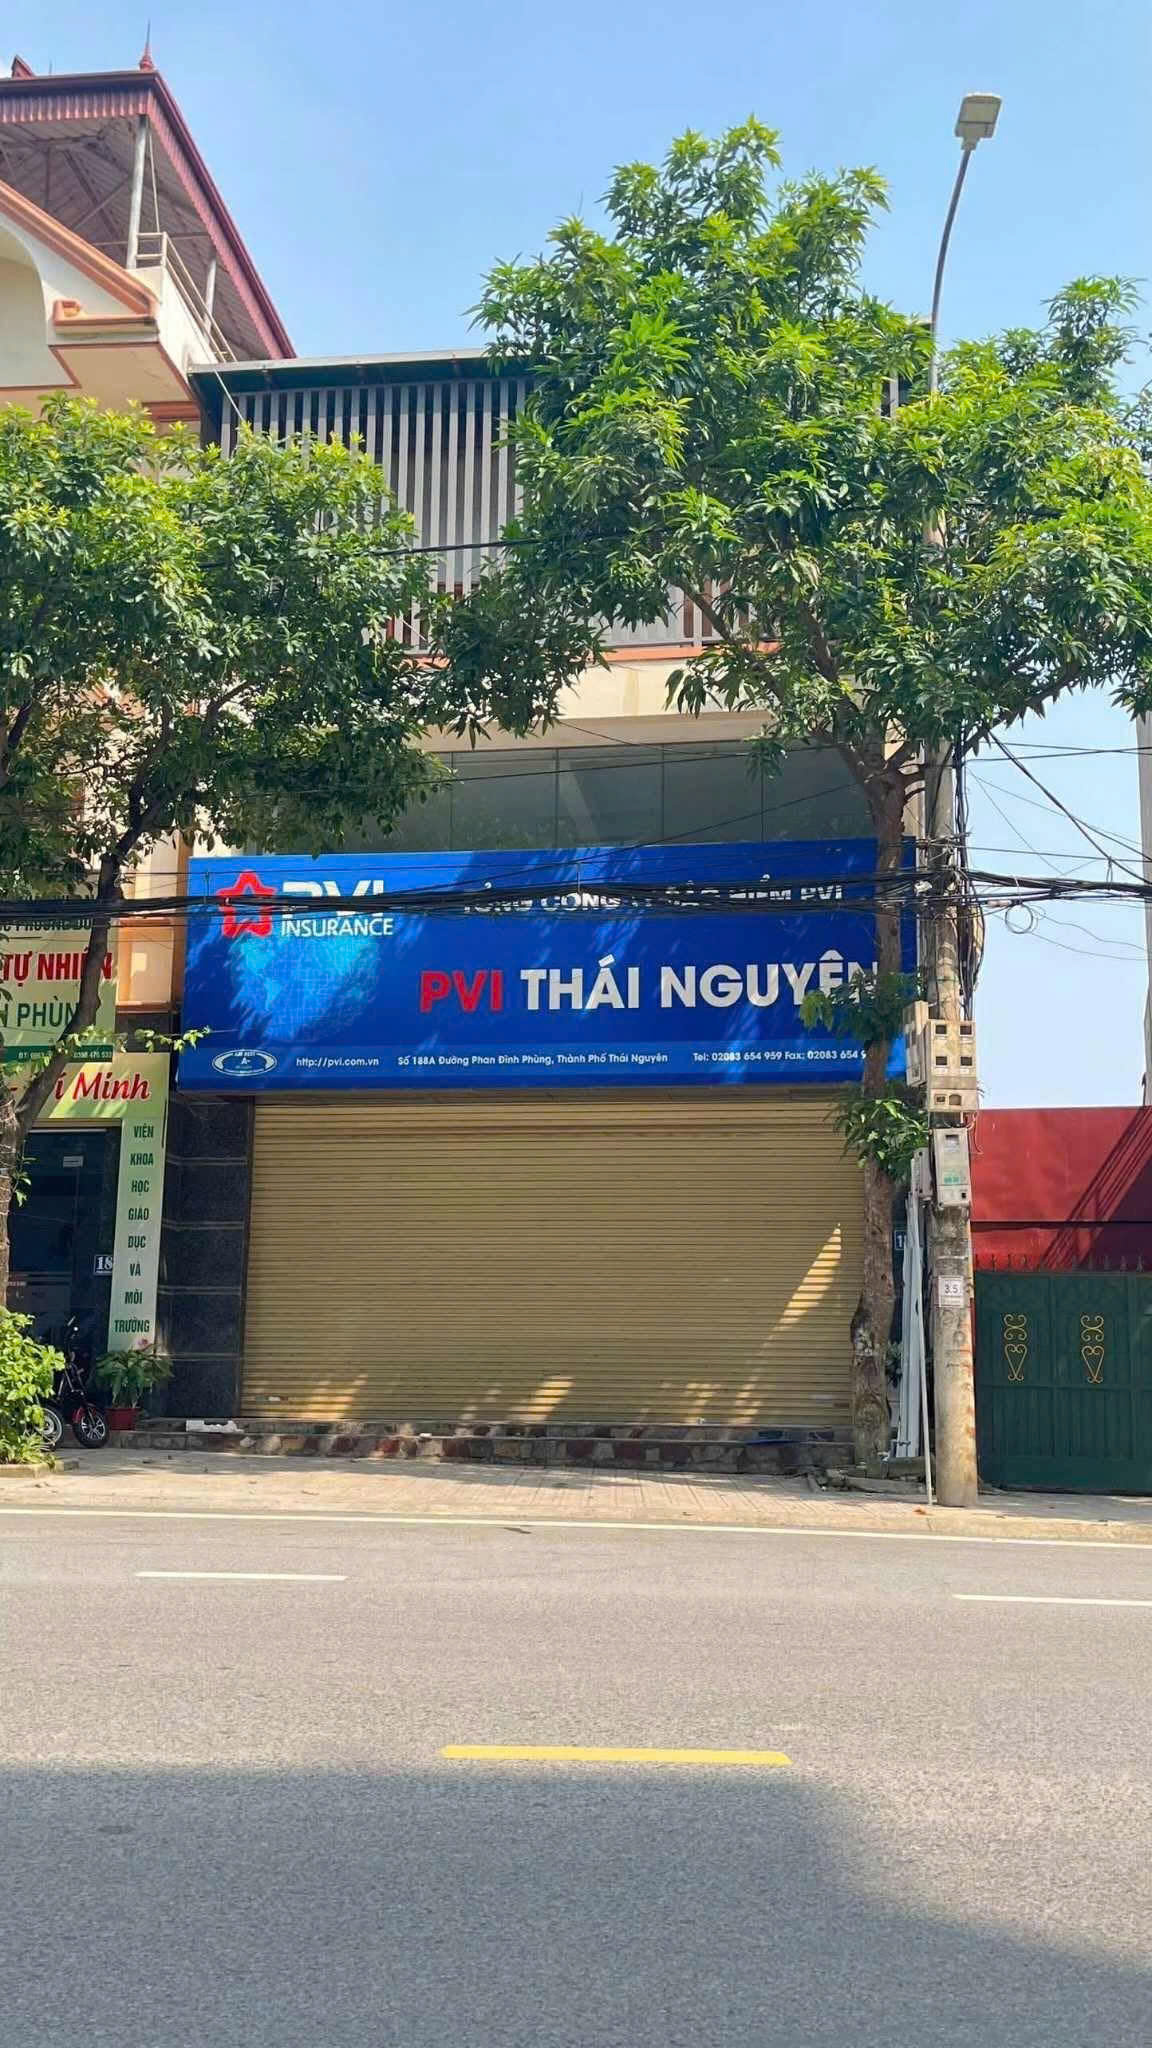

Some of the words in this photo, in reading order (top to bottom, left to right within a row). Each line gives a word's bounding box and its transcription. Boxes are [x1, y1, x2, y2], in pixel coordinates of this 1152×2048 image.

[281, 918, 393, 937] INSURANCE
[4, 950, 33, 987] TỰ
[420, 969, 502, 1013] PVI
[520, 954, 640, 1010] THÁI
[296, 1057, 379, 1067] http://pvi.com.vn
[397, 1055, 409, 1065] Số
[412, 1056, 435, 1065] 188A
[438, 1055, 469, 1067] Đường
[471, 1055, 495, 1065] Phan
[499, 1055, 519, 1064] Đình
[521, 1053, 555, 1066] Phùng,
[557, 1053, 585, 1063] Thành
[588, 1051, 606, 1063] Phố
[609, 1052, 628, 1063] Thái
[631, 1052, 667, 1065] Nguyên
[693, 1052, 708, 1062] Tel:
[711, 1052, 741, 1062] 02083
[743, 1052, 761, 1061] 654
[764, 1051, 782, 1060] 959
[784, 1051, 804, 1061] Fax:
[807, 1050, 837, 1060] 02083
[840, 1050, 857, 1059] 654
[73, 1071, 149, 1100] Minh
[130, 1153, 154, 1166] KHOA
[131, 1180, 150, 1196] HỌC
[128, 1205, 150, 1221] GIÁO
[114, 1316, 150, 1333] TRƯỜNG
